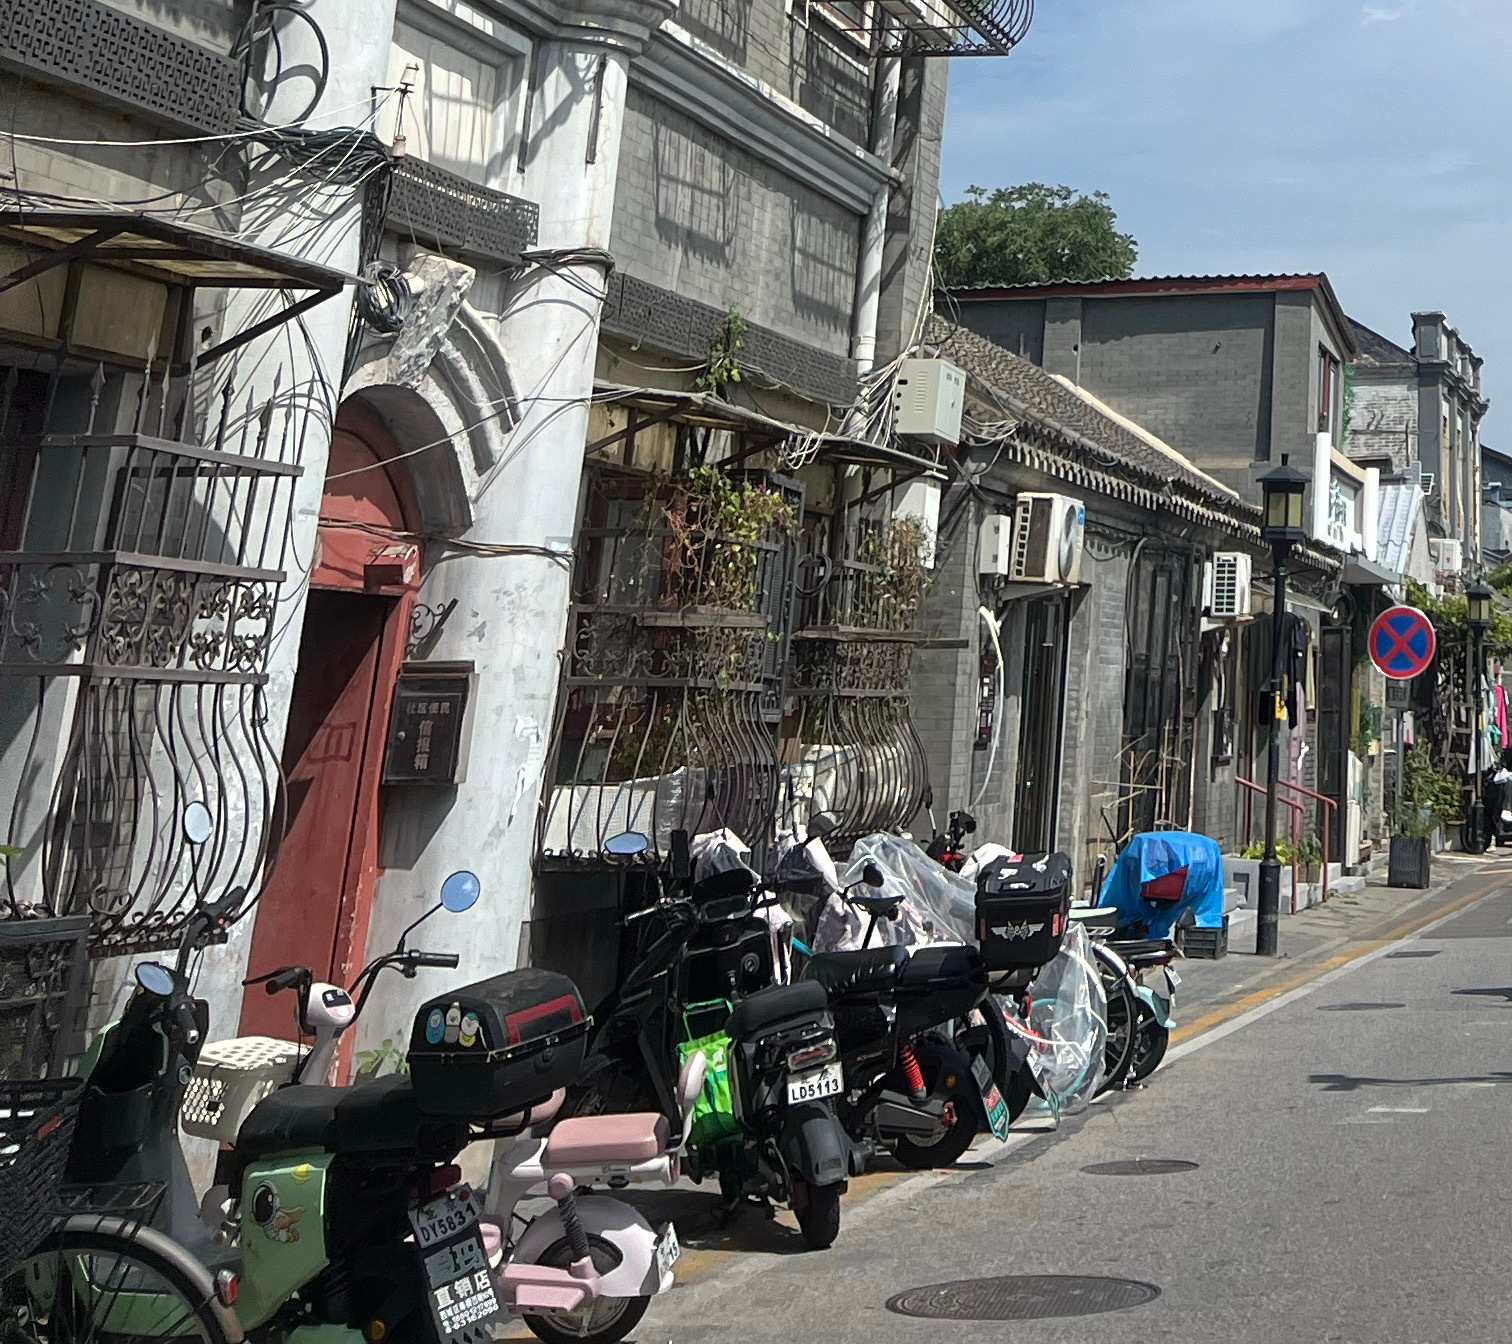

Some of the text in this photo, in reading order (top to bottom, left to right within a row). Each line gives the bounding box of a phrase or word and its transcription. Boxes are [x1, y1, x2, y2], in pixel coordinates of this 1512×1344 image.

[413, 720, 434, 770] 信报箱
[433, 1269, 491, 1311] 直销店
